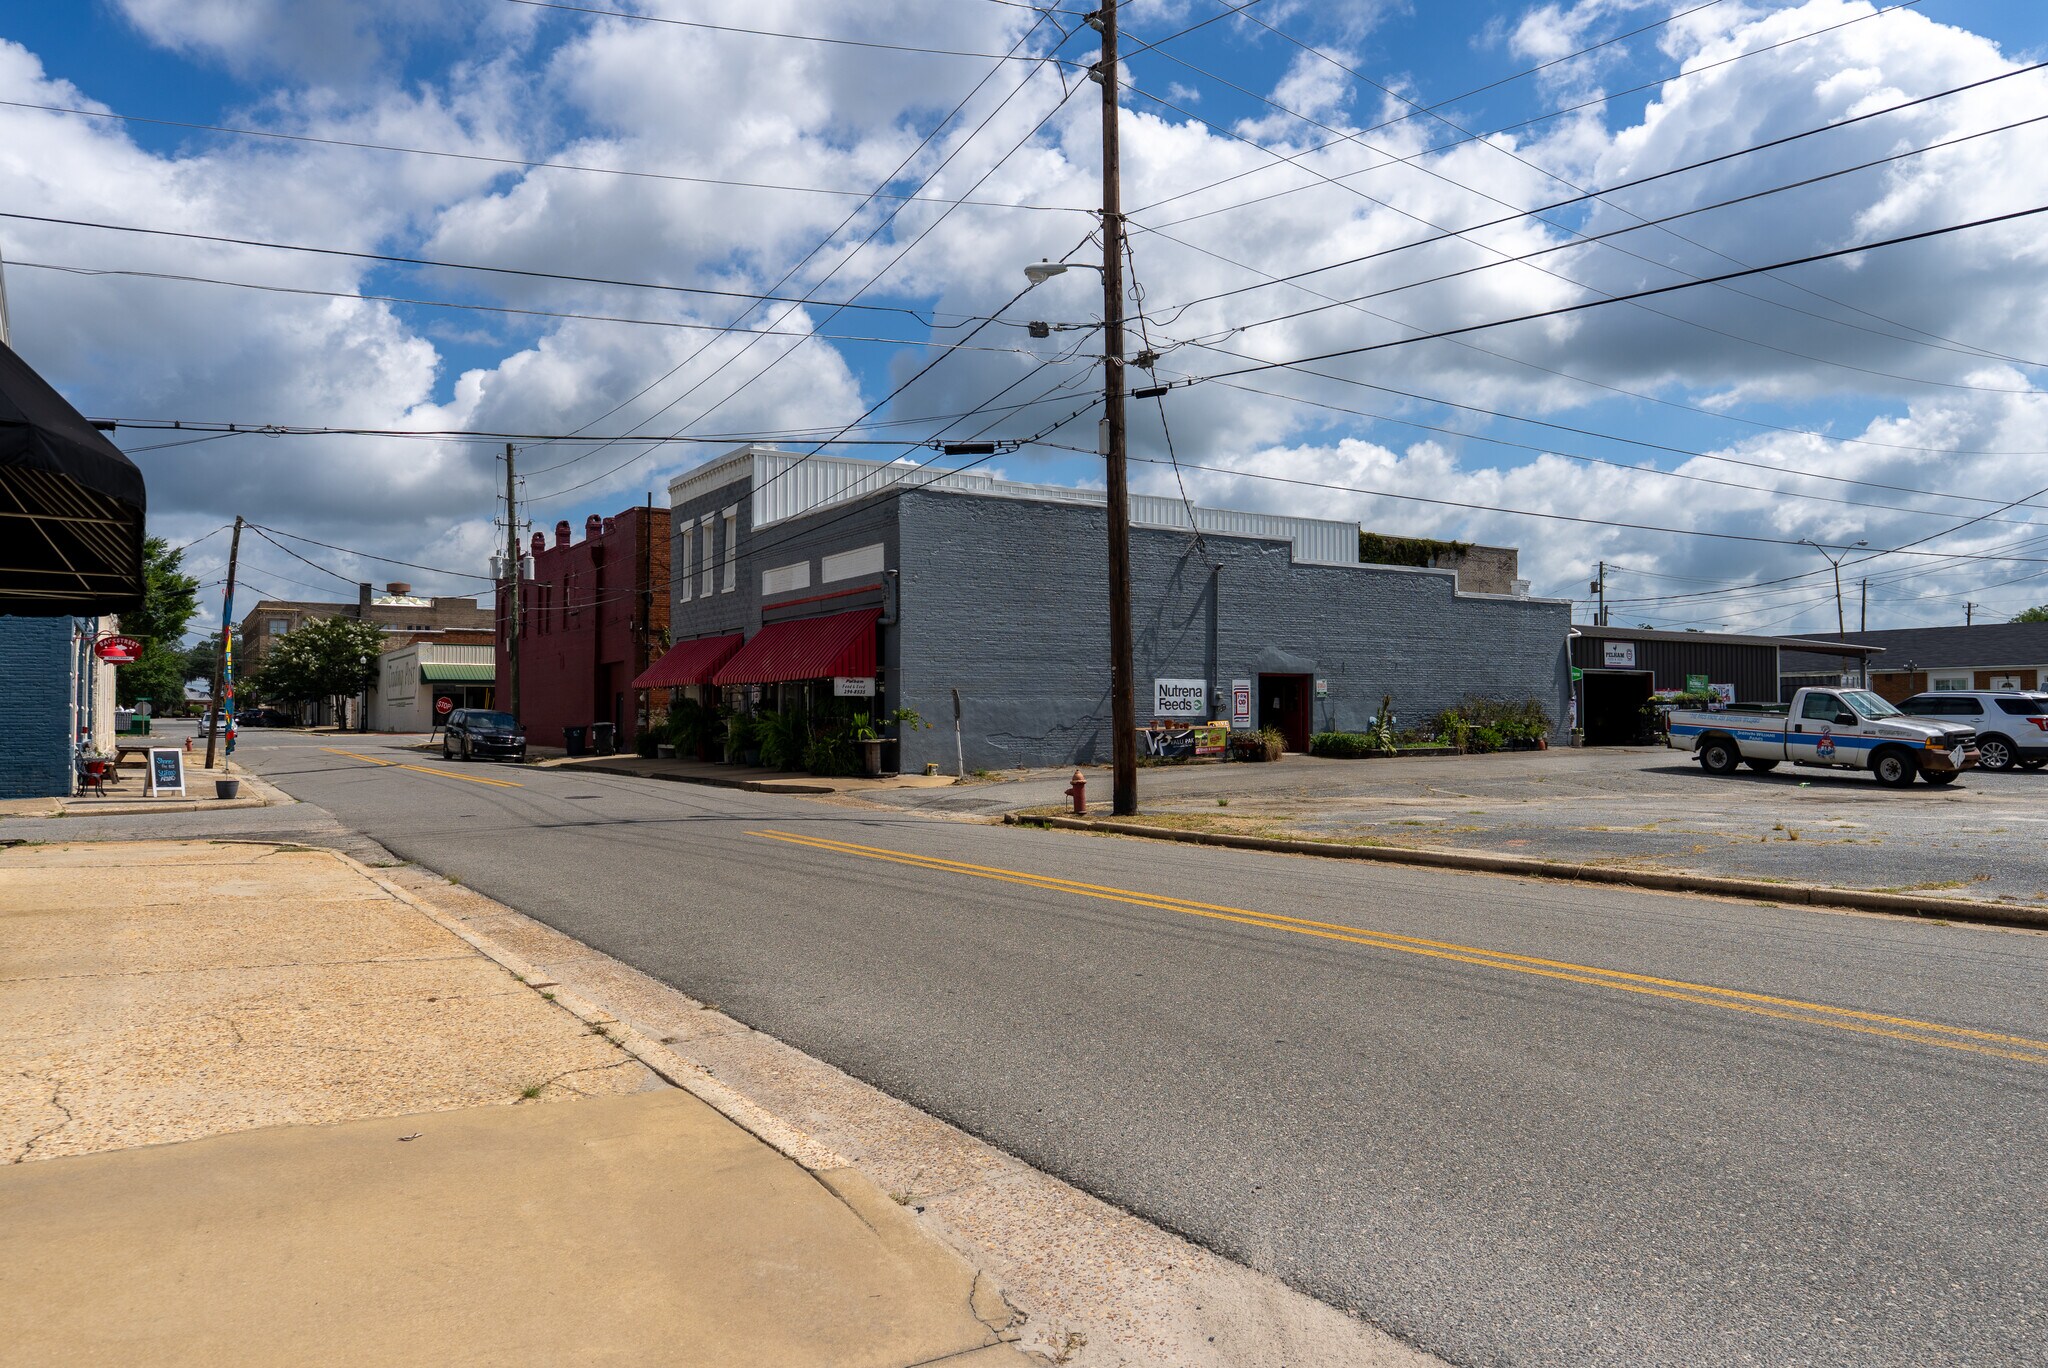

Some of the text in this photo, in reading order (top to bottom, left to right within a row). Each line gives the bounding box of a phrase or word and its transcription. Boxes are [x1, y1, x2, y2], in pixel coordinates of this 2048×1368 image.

[1159, 684, 1203, 698] Nutrena
[437, 701, 452, 709] STOP
[1159, 698, 1192, 711] Feeds
